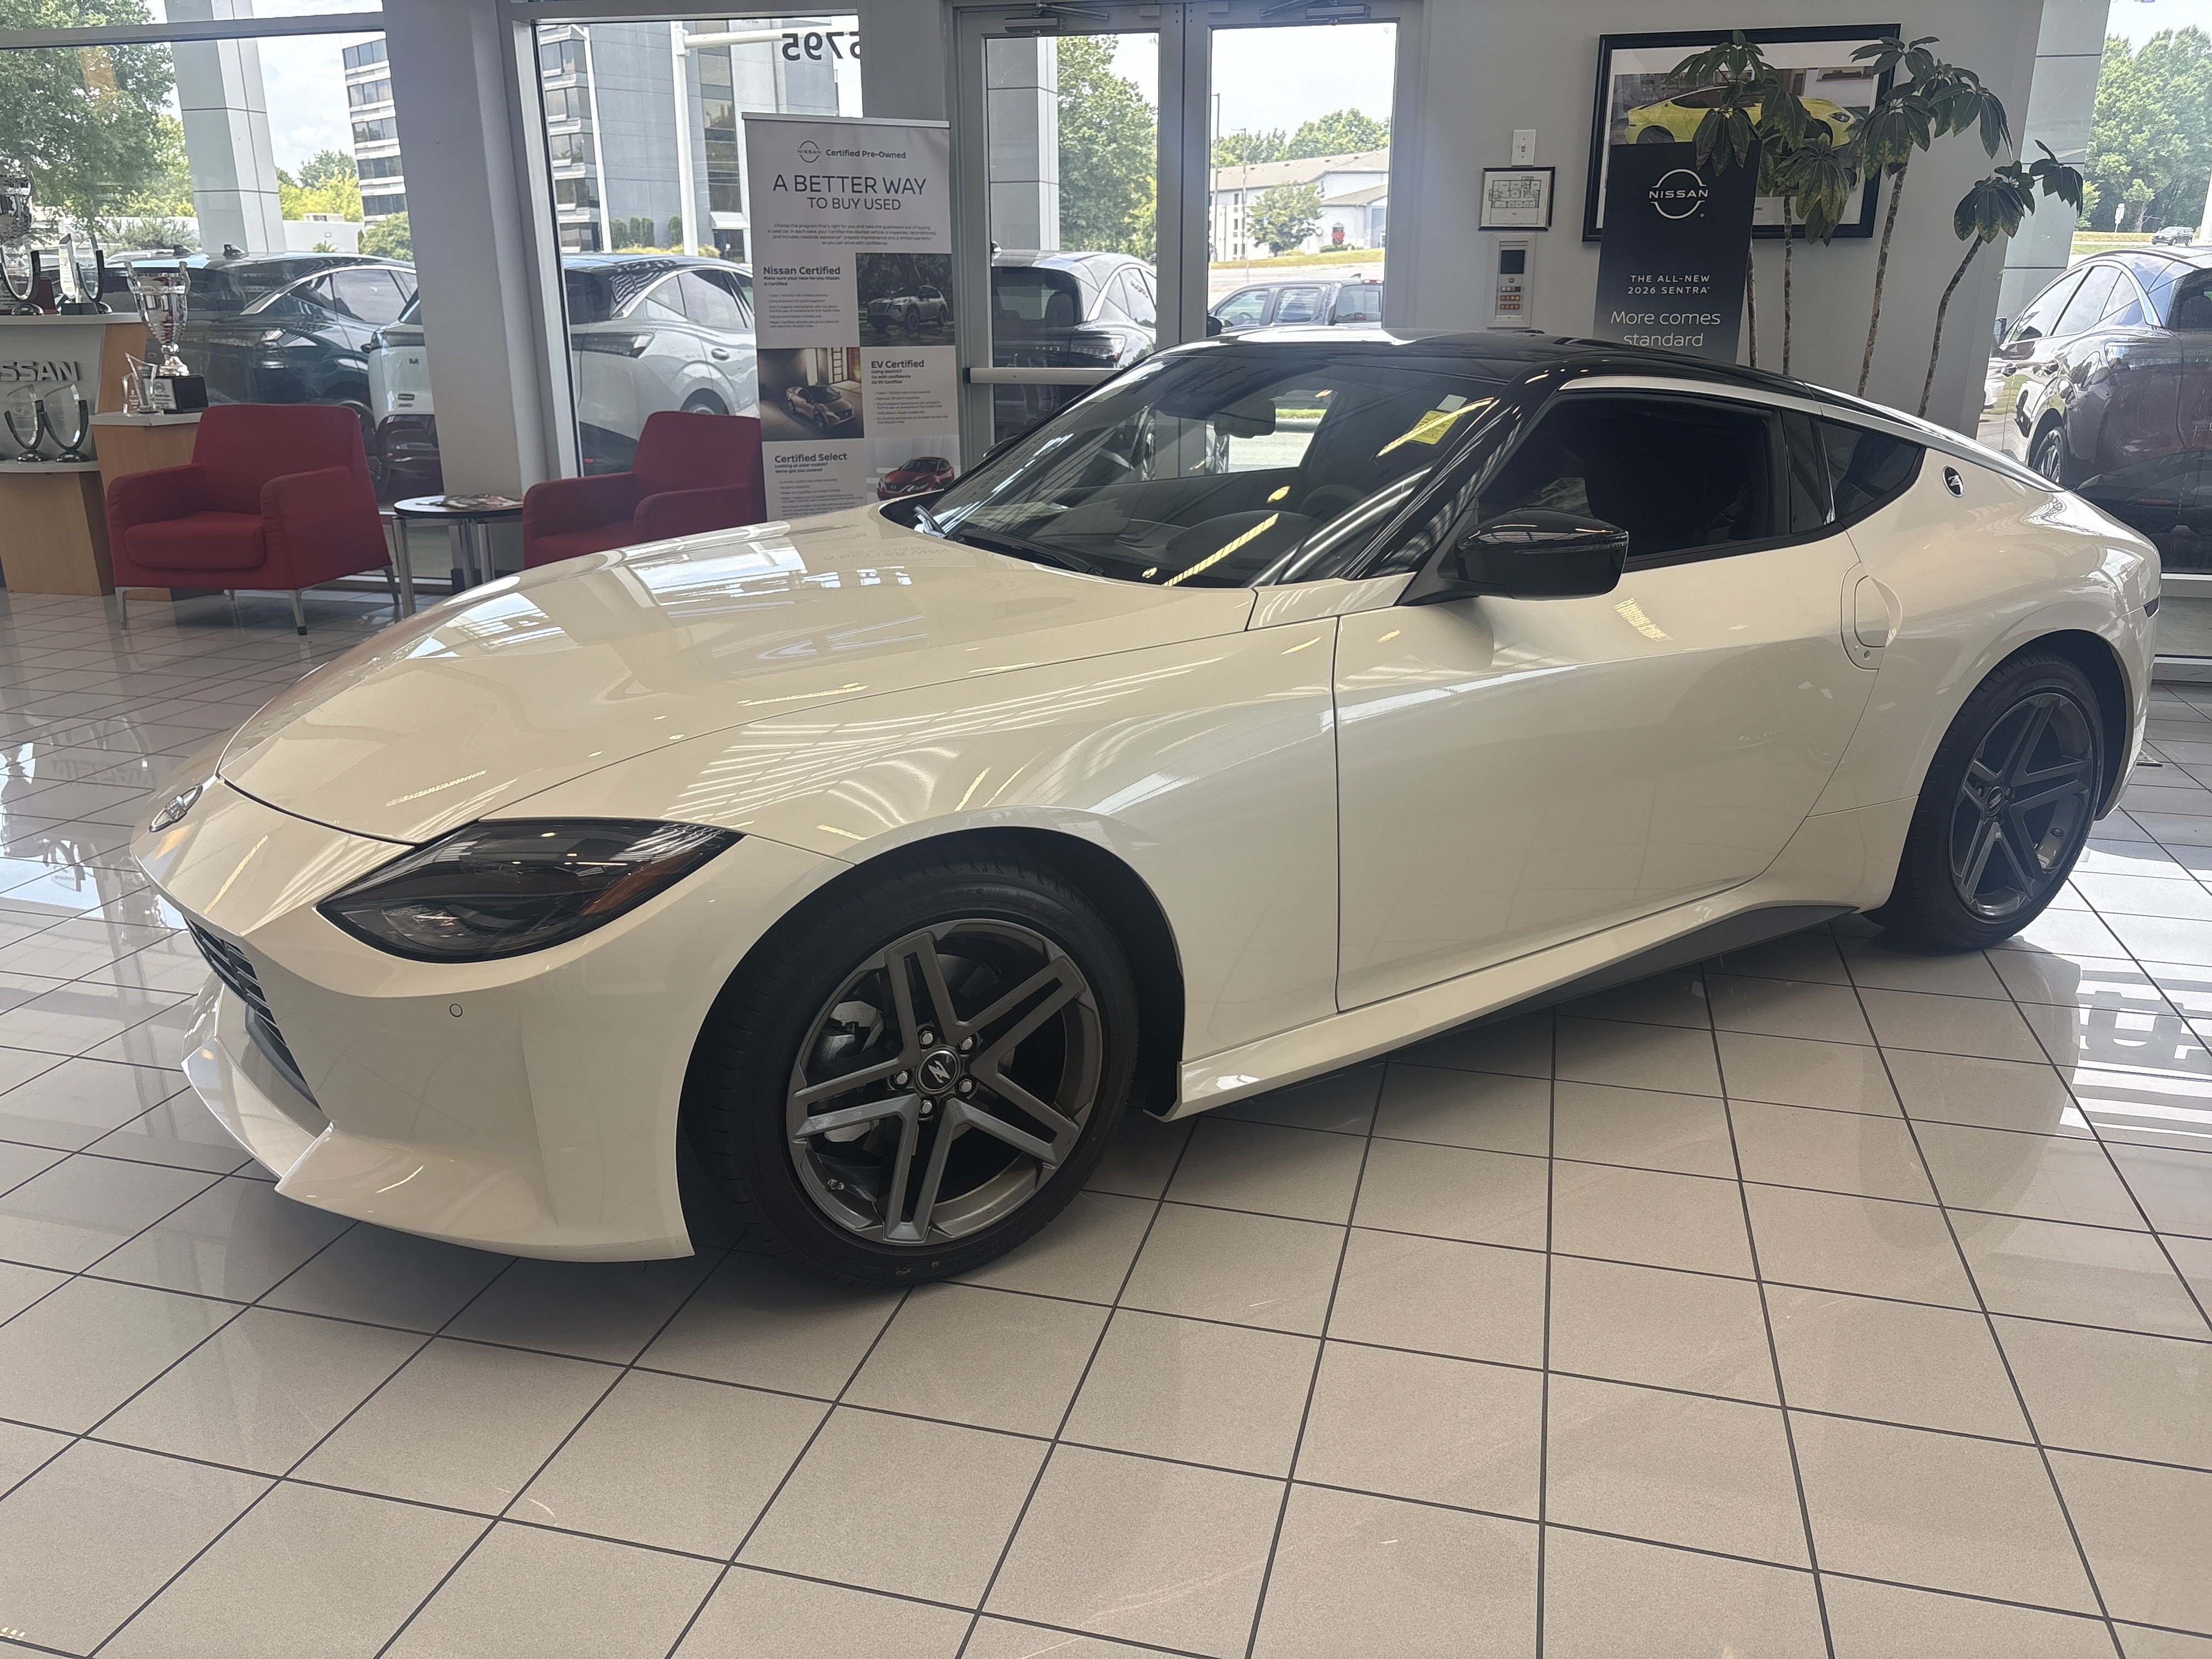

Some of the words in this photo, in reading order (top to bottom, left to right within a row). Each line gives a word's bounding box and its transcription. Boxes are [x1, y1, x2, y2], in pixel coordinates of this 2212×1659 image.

[826, 149, 860, 157] Certified
[862, 150, 906, 159] Pre-Owned
[773, 174, 788, 192] A
[794, 174, 877, 194] BETTER
[882, 177, 927, 195] WAY
[1649, 189, 1709, 199] NISSAN
[806, 197, 827, 210] TO
[832, 198, 860, 210] BUY
[864, 198, 901, 211] USED
[763, 266, 797, 274] Nissan
[799, 266, 841, 275] Certified
[1657, 274, 1710, 283] ALL-NEW
[1627, 286, 1656, 295] 2026
[1610, 311, 1655, 325] More
[1659, 313, 1721, 325] comes
[1623, 332, 1704, 347] standard
[885, 359, 924, 368] Certified
[0, 361, 81, 382] SSAN
[774, 454, 816, 462] Certified
[819, 453, 848, 461] Select
